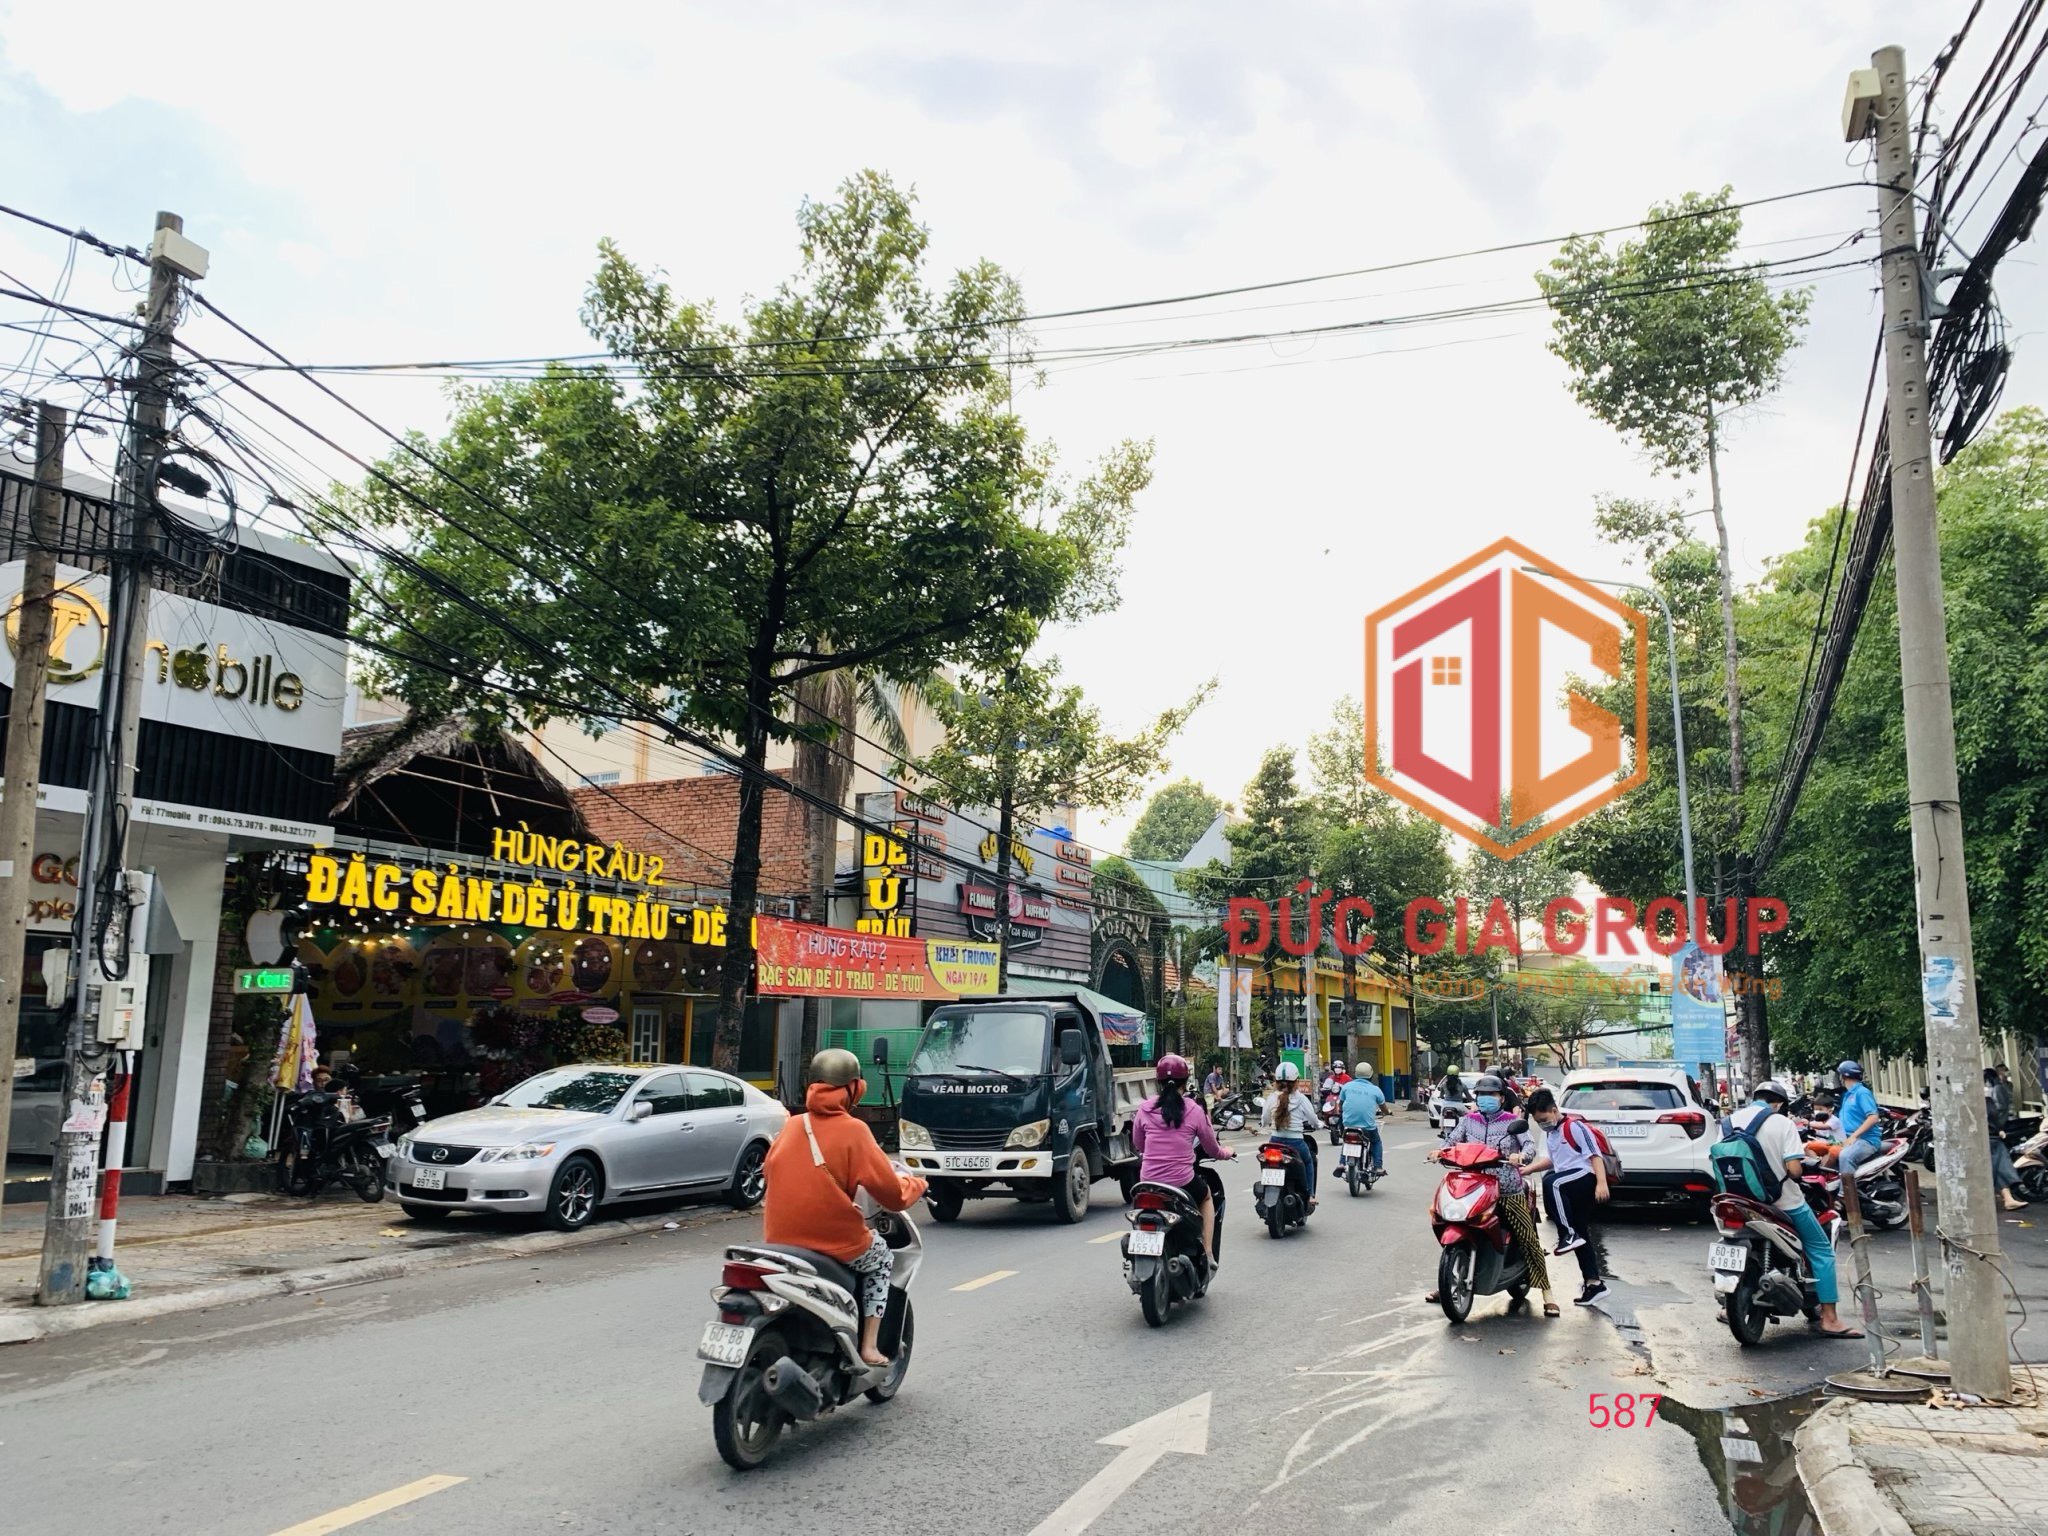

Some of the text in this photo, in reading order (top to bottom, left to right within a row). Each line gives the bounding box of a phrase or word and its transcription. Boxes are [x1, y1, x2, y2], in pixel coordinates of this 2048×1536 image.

[492, 820, 664, 886] HÙNG RÂU 2
[306, 852, 402, 917] ĐẶC
[411, 863, 494, 922] SẢN
[501, 878, 549, 928] DÊ
[557, 879, 580, 930] Ủ
[588, 891, 669, 940] TRẤU
[692, 904, 727, 947] DÊ
[868, 866, 901, 910] Ủ
[1025, 904, 1050, 920] BUFFALO
[1099, 920, 1138, 947] COFFEE
[879, 943, 888, 960] 2
[932, 1085, 1009, 1094] VEAM MOTOR
